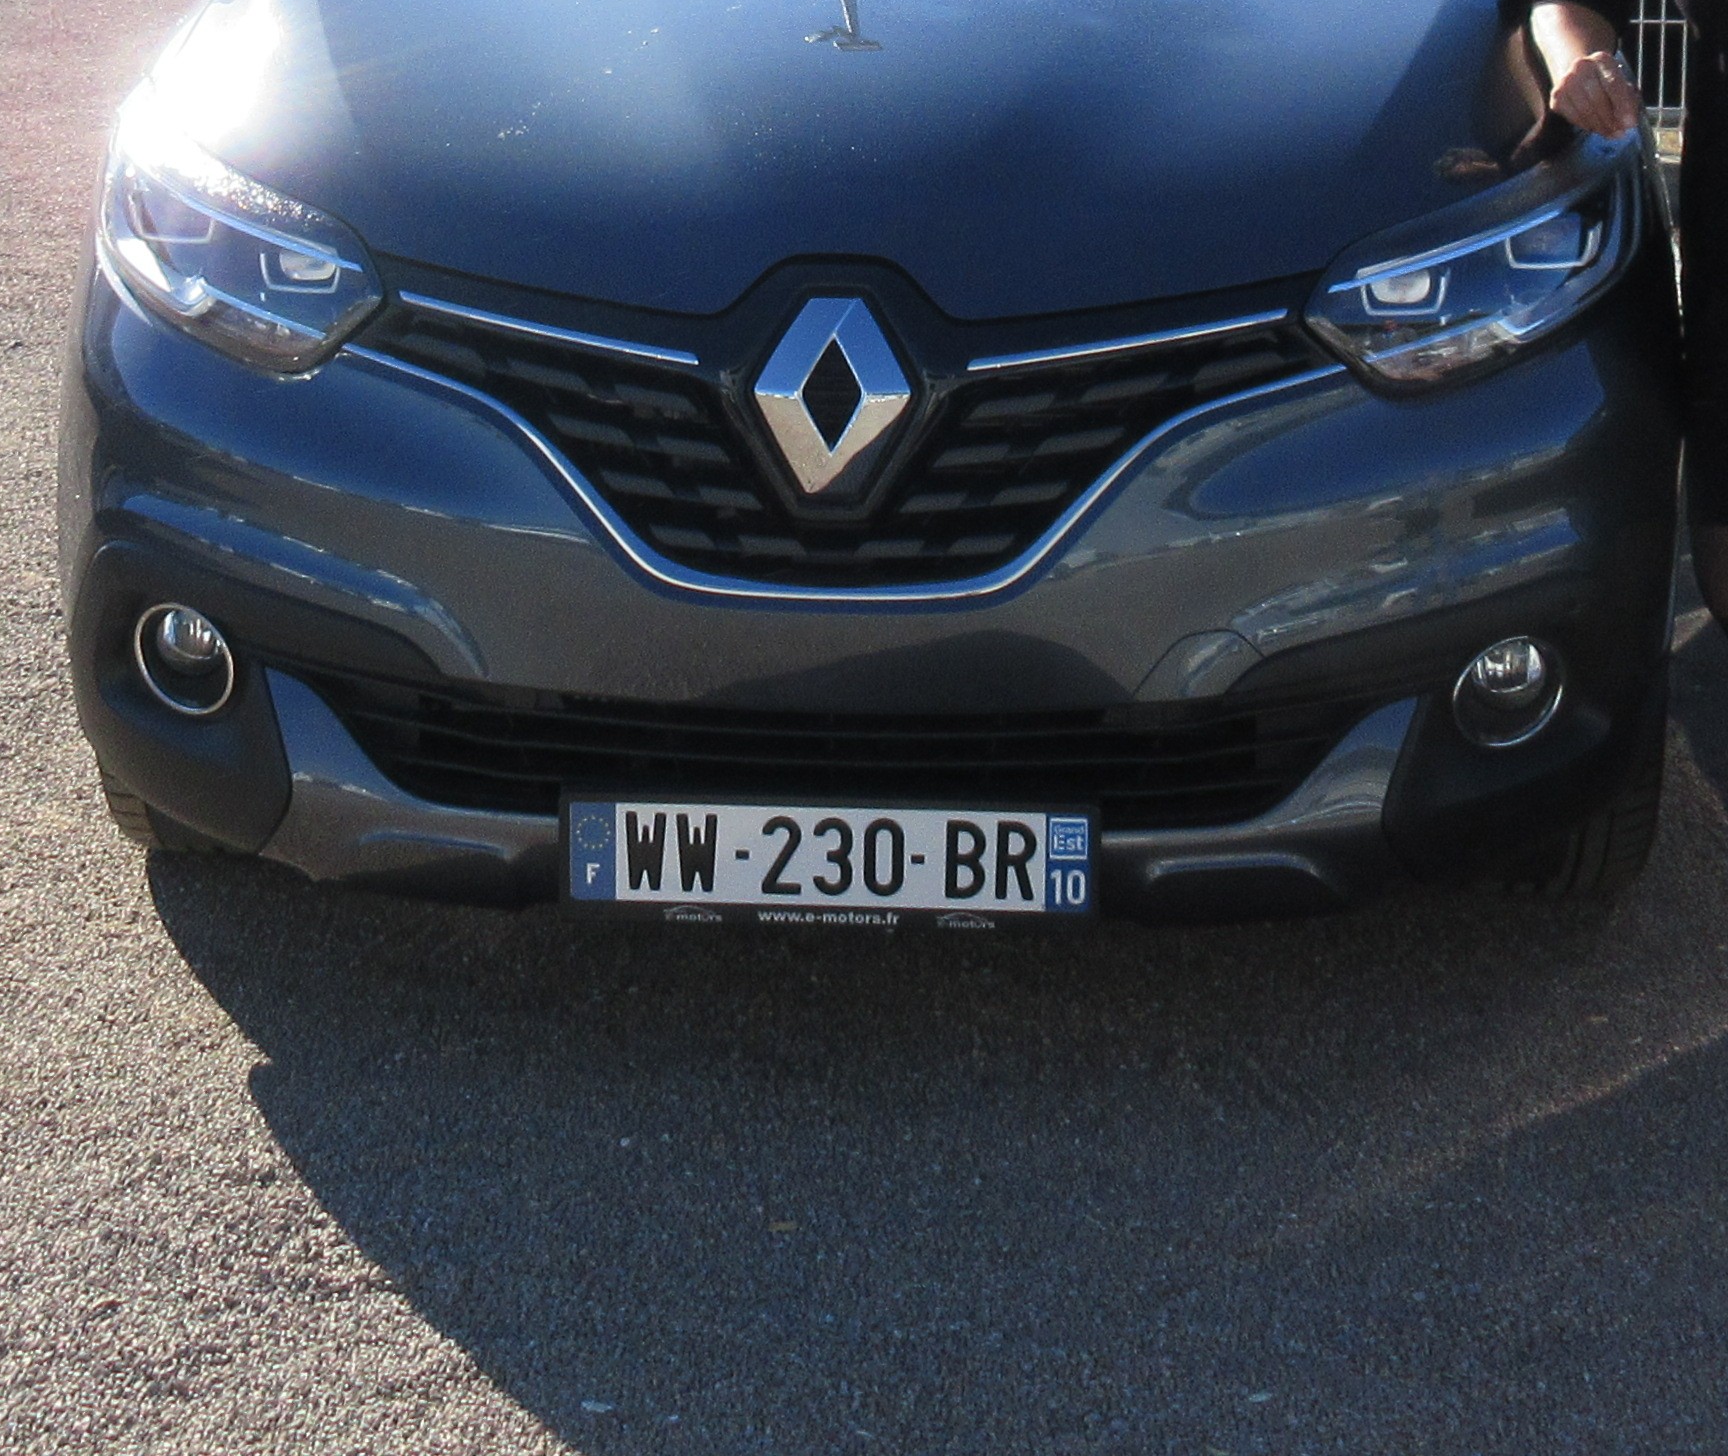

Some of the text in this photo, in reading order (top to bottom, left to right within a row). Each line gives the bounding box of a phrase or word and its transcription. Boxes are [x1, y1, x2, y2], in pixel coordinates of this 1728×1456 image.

[1053, 834, 1083, 851] Est
[586, 863, 601, 885] F
[1050, 869, 1086, 905] 10
[757, 911, 900, 926] www.e-motors.fr
